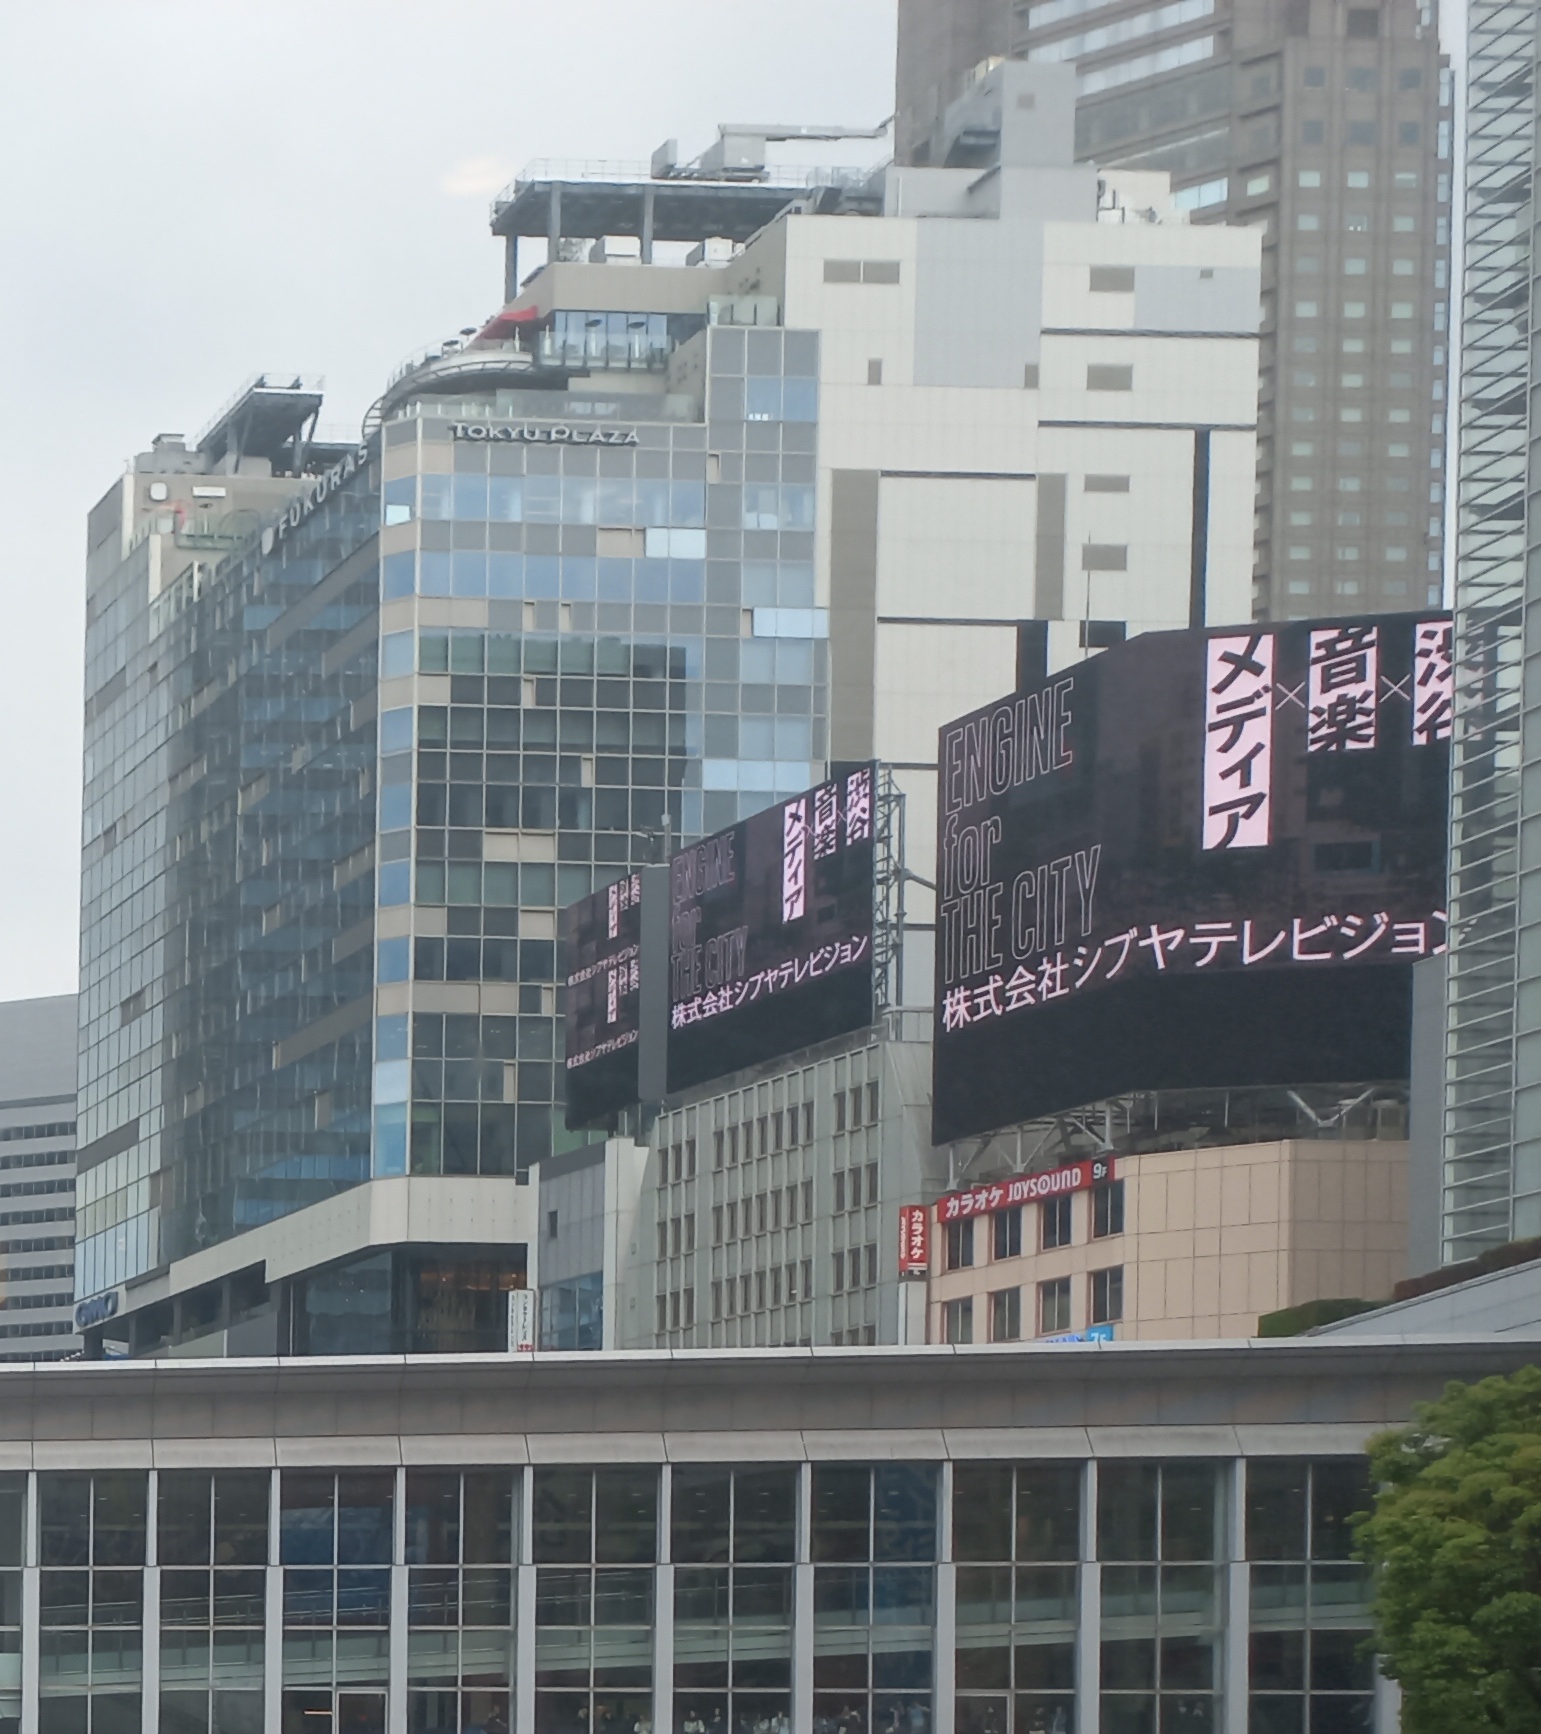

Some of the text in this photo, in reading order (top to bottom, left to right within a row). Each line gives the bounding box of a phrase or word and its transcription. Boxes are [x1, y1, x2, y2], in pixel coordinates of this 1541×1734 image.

[452, 422, 639, 444] TOKYU PLAZA
[1309, 628, 1377, 750] 音楽
[945, 677, 1075, 815] ENGINE
[1204, 636, 1273, 850] メディア
[783, 799, 805, 924] メディア
[943, 815, 1002, 900] for
[941, 845, 1102, 984] THE CITY
[671, 935, 868, 1029] 株式会社シブヤテレビジョン
[945, 1167, 1081, 1218] カラオケ JOYSOUND
[1093, 1162, 1108, 1180] 9F
[910, 1209, 924, 1259] カラオケ
